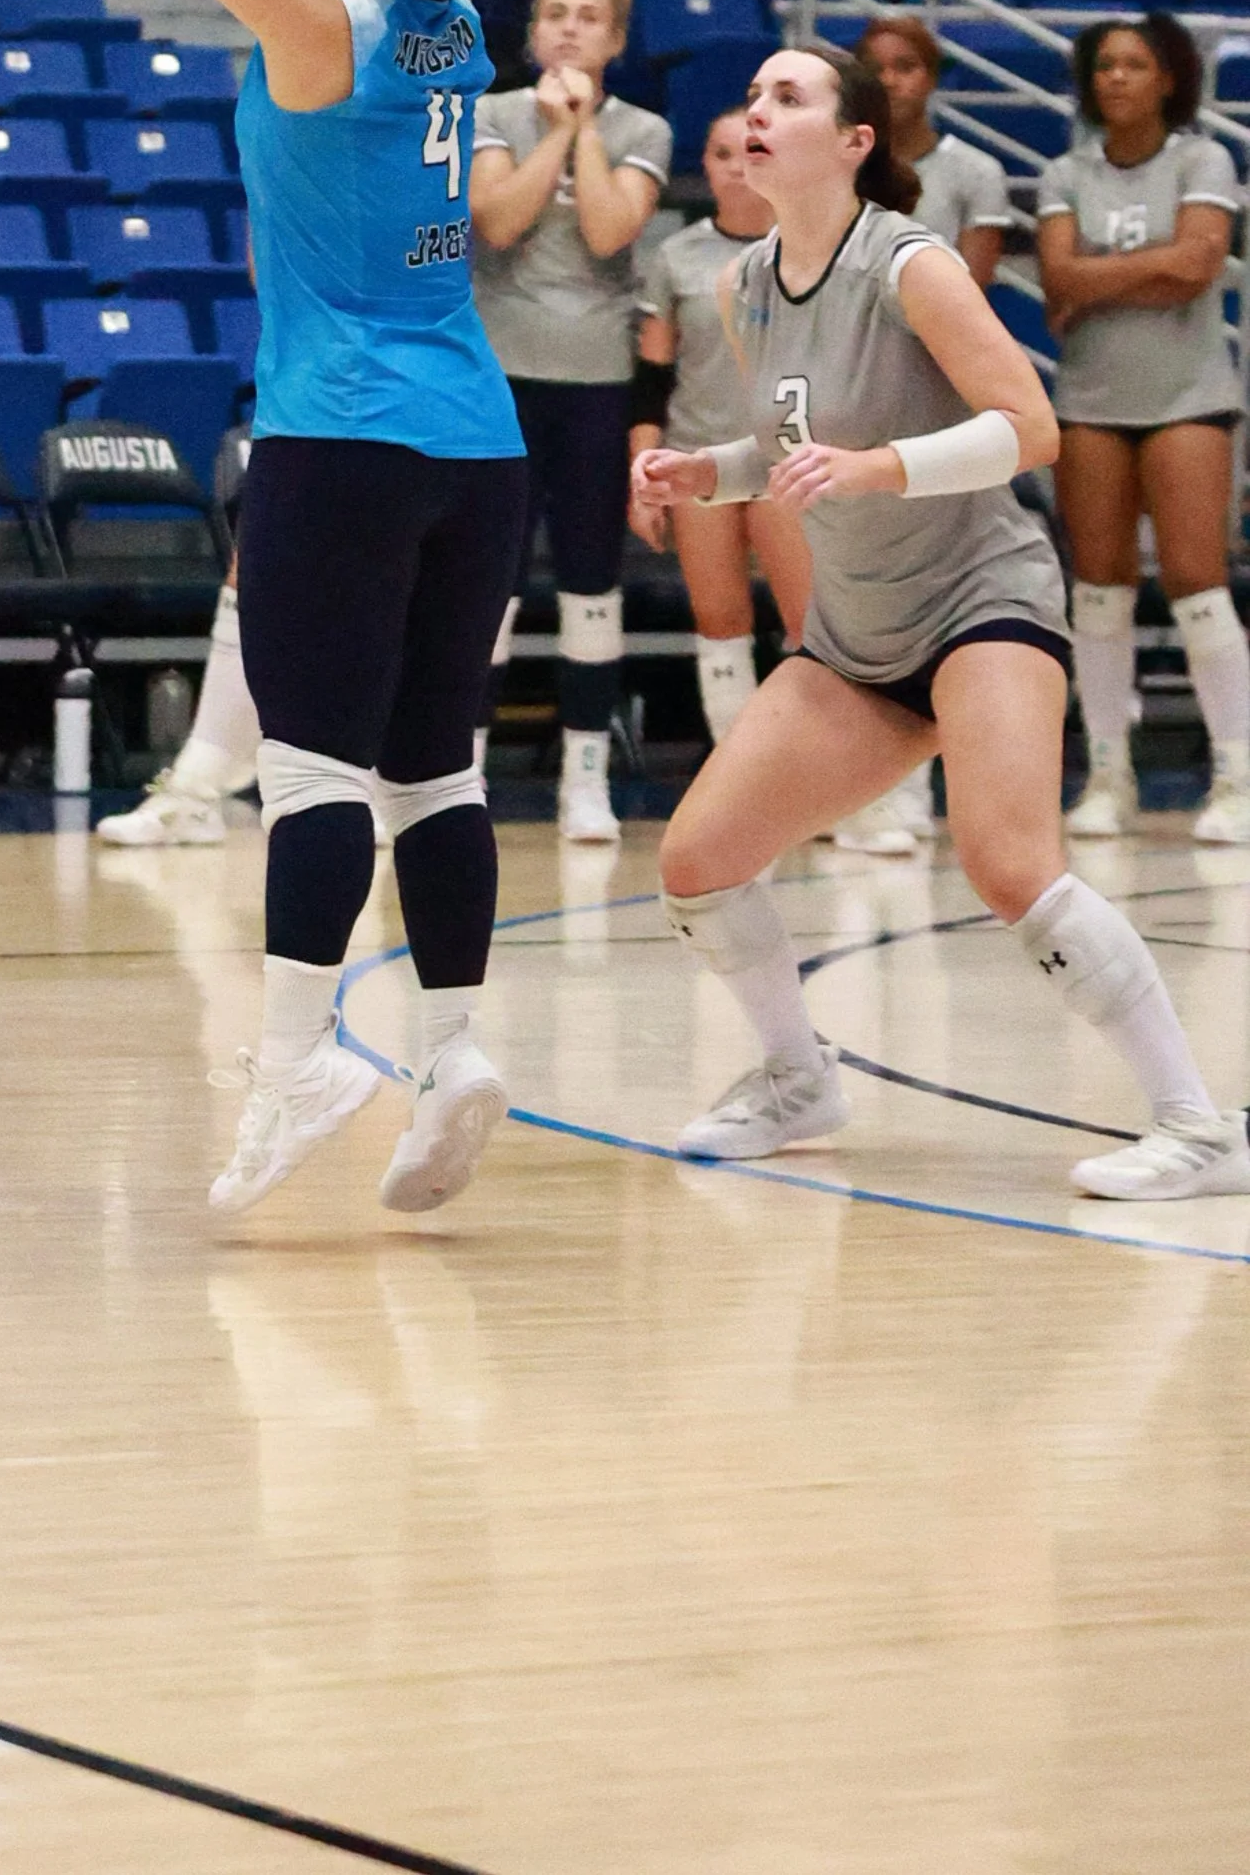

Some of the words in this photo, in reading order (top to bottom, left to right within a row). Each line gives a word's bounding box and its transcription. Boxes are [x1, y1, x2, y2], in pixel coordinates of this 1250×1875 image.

[422, 87, 464, 202] 4
[59, 436, 179, 472] AUGUSTA
[774, 374, 815, 457] 3
